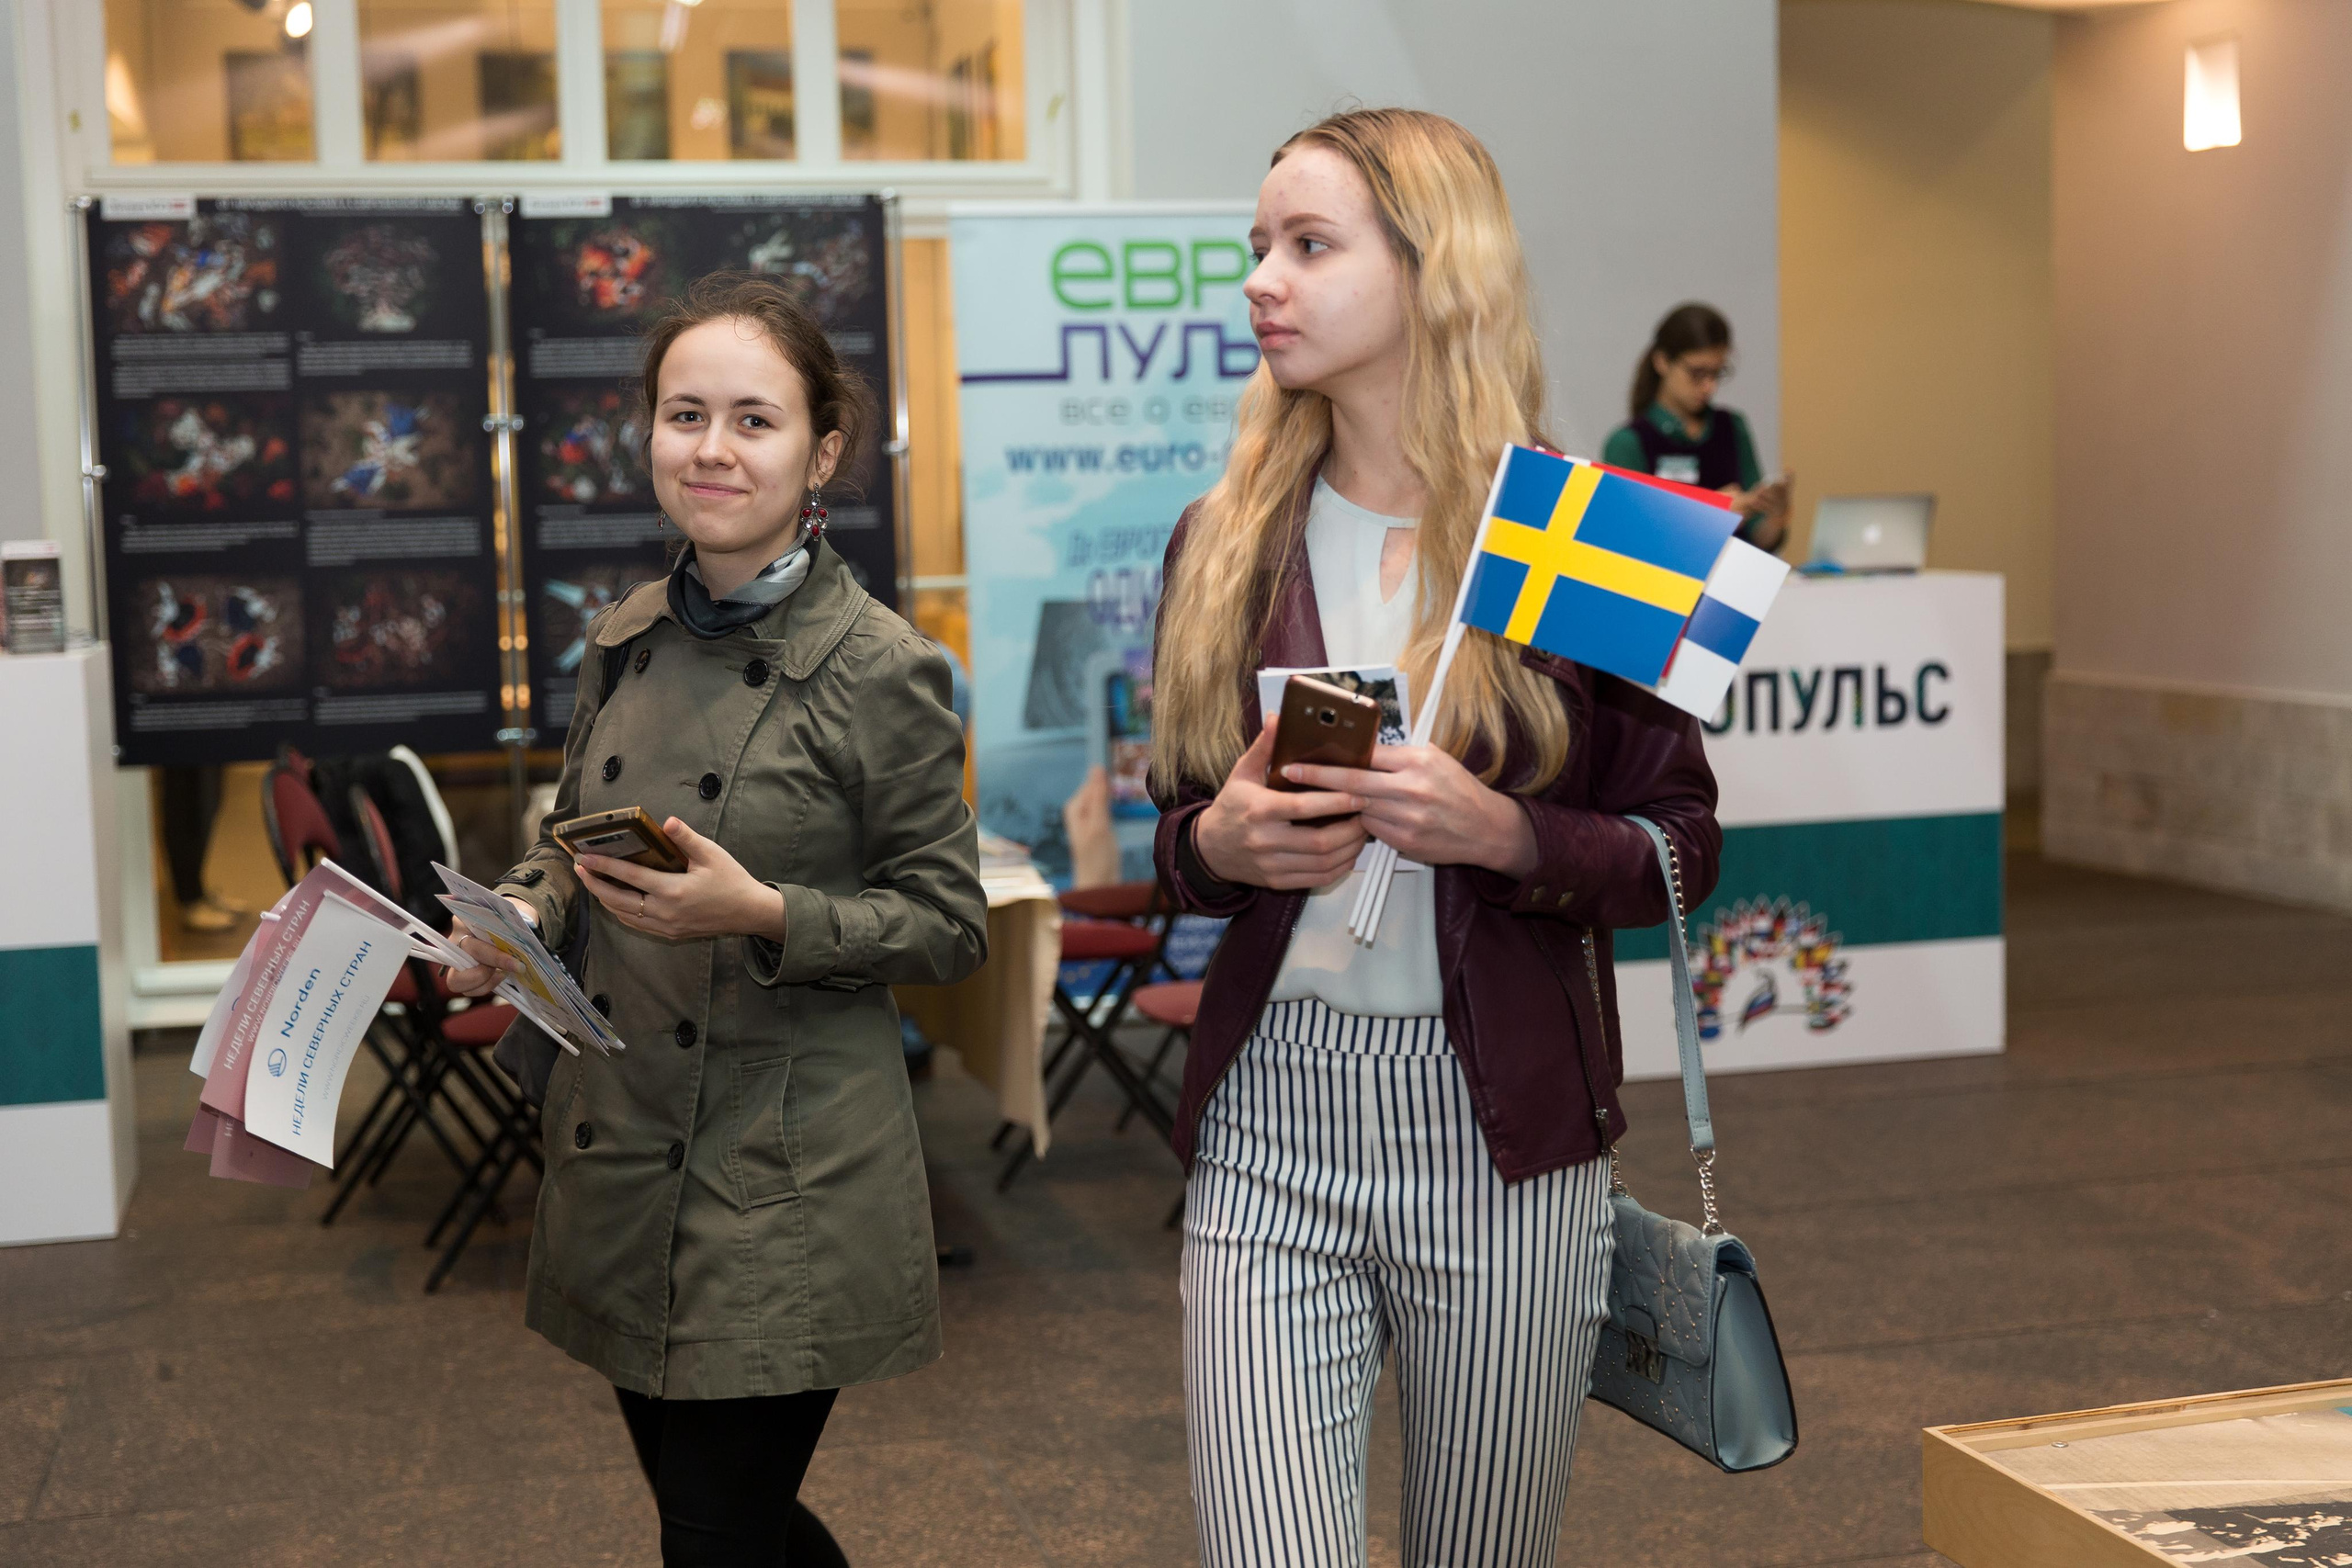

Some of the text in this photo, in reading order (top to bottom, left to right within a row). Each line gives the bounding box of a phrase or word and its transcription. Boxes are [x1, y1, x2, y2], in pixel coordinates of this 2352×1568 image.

[223, 900, 311, 1070] НЕДЕЛИ СЕВЕРНЫХ СТРАН
[280, 968, 321, 1038] Norden
[292, 941, 372, 1136] НЕДЕЛИ СЕВЕРНЫХ СТРАН
